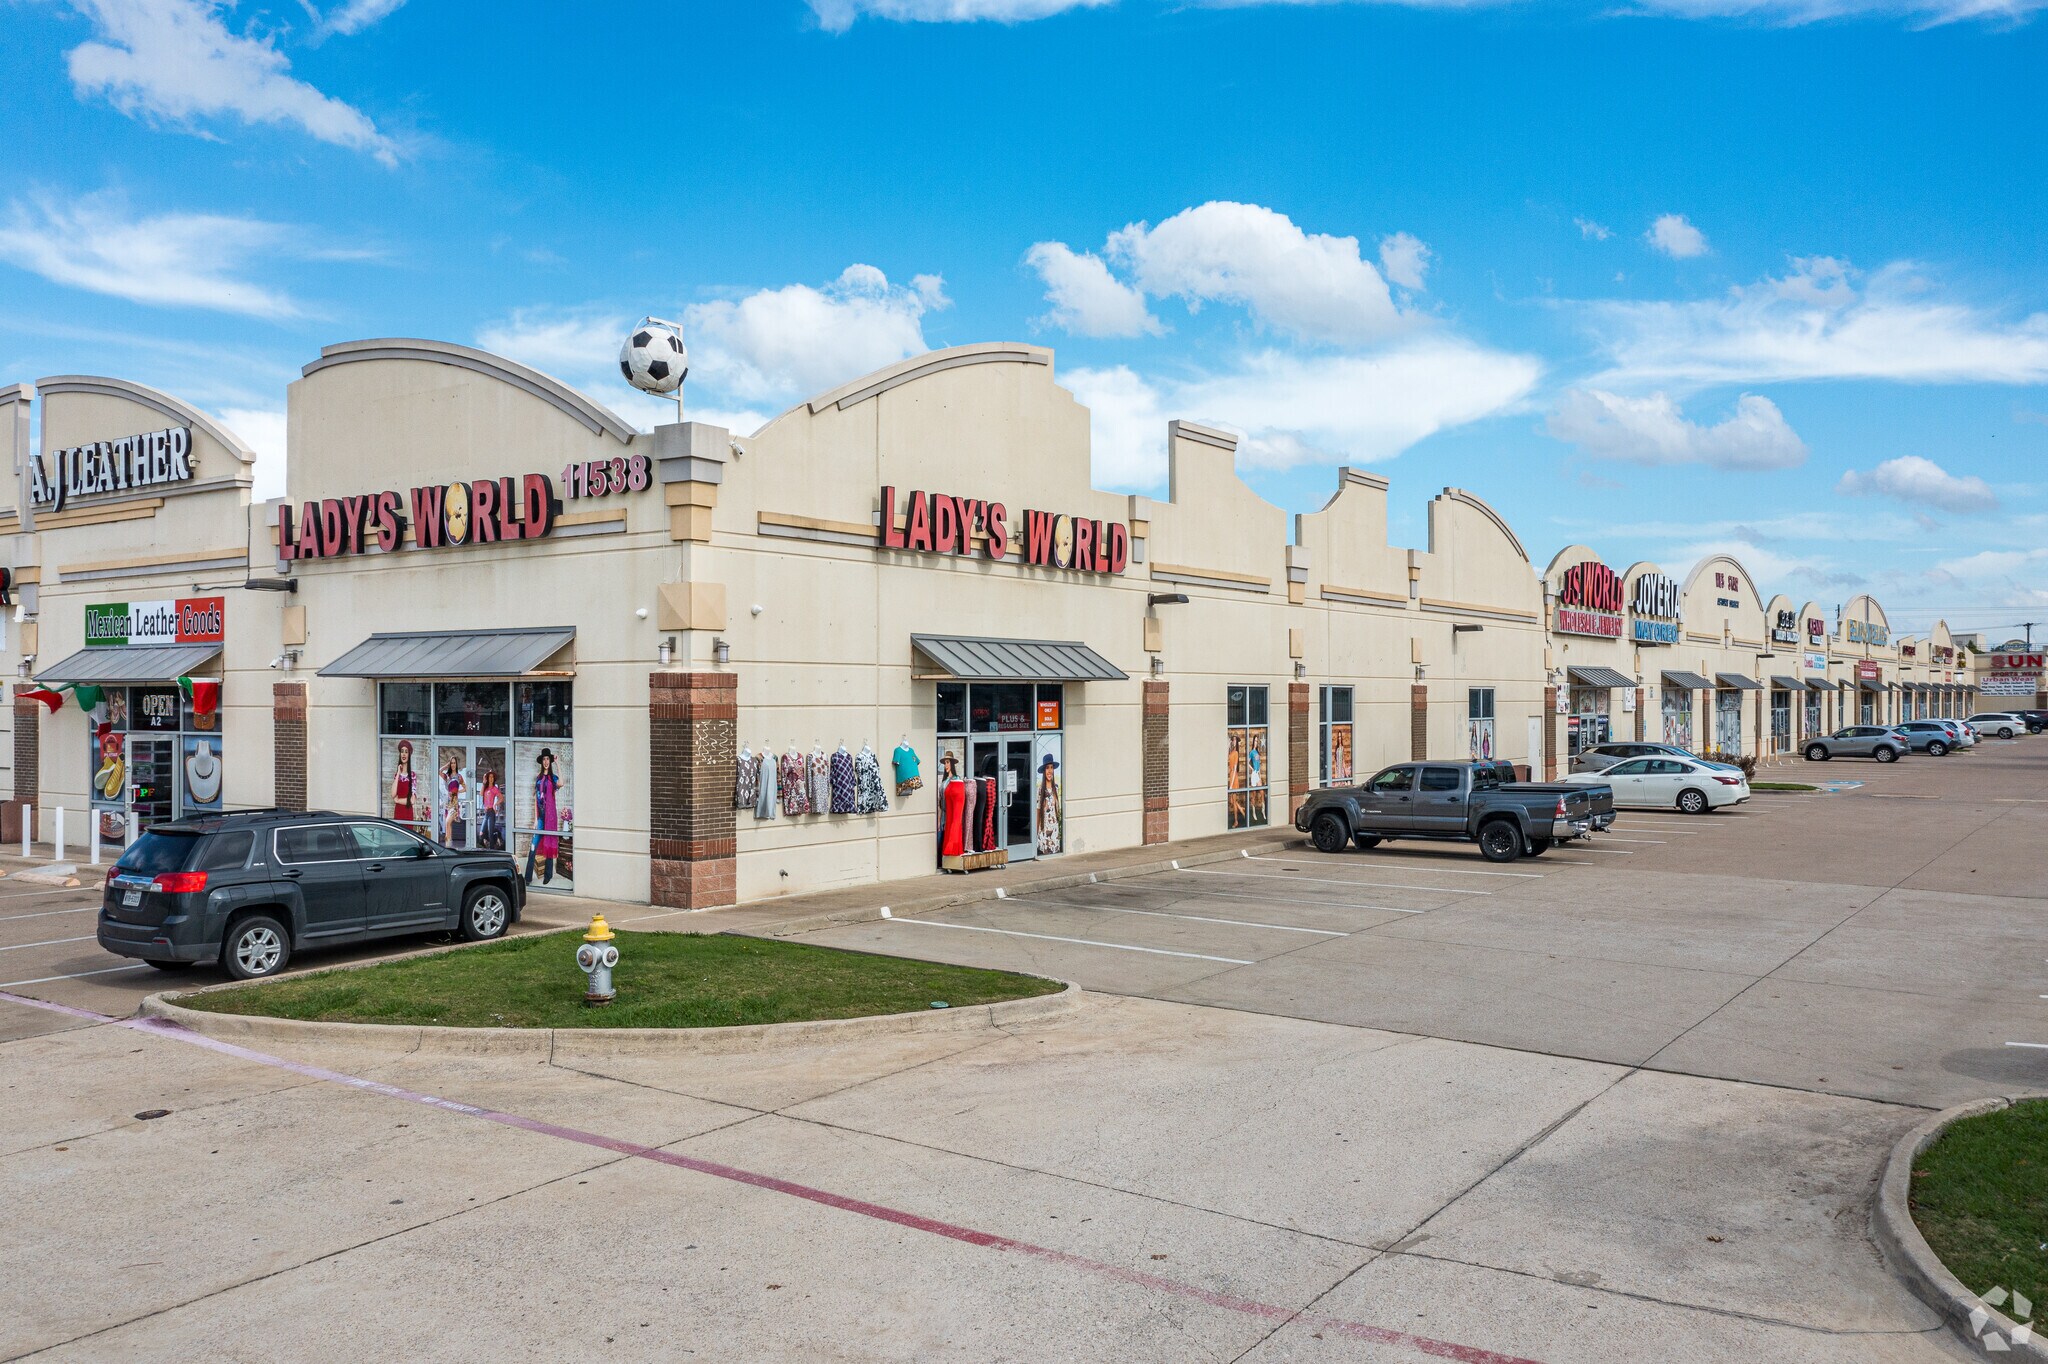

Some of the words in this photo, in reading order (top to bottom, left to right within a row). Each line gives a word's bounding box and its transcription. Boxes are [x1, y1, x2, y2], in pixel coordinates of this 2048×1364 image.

[66, 426, 194, 497] LEATHER
[560, 454, 653, 499] 11538
[278, 490, 404, 561] LADY'S
[410, 473, 555, 549] WORLD
[880, 485, 1008, 560] LADY'S
[1022, 508, 1128, 574] WORLD
[1580, 561, 1625, 612] WORLD
[1634, 573, 1681, 619] JOYERIA
[87, 608, 133, 639] Mexican
[134, 605, 180, 637] Leather
[182, 601, 221, 636] Goods
[1559, 609, 1598, 635] WHOLESALE
[1597, 615, 1624, 637] JEWELRY
[1634, 620, 1679, 643] MAYOREO
[1991, 655, 2042, 668] SUN
[142, 694, 175, 717] OPEN
[150, 716, 162, 727] A2
[1001, 714, 1019, 723] PLUS
[1020, 714, 1025, 723] &
